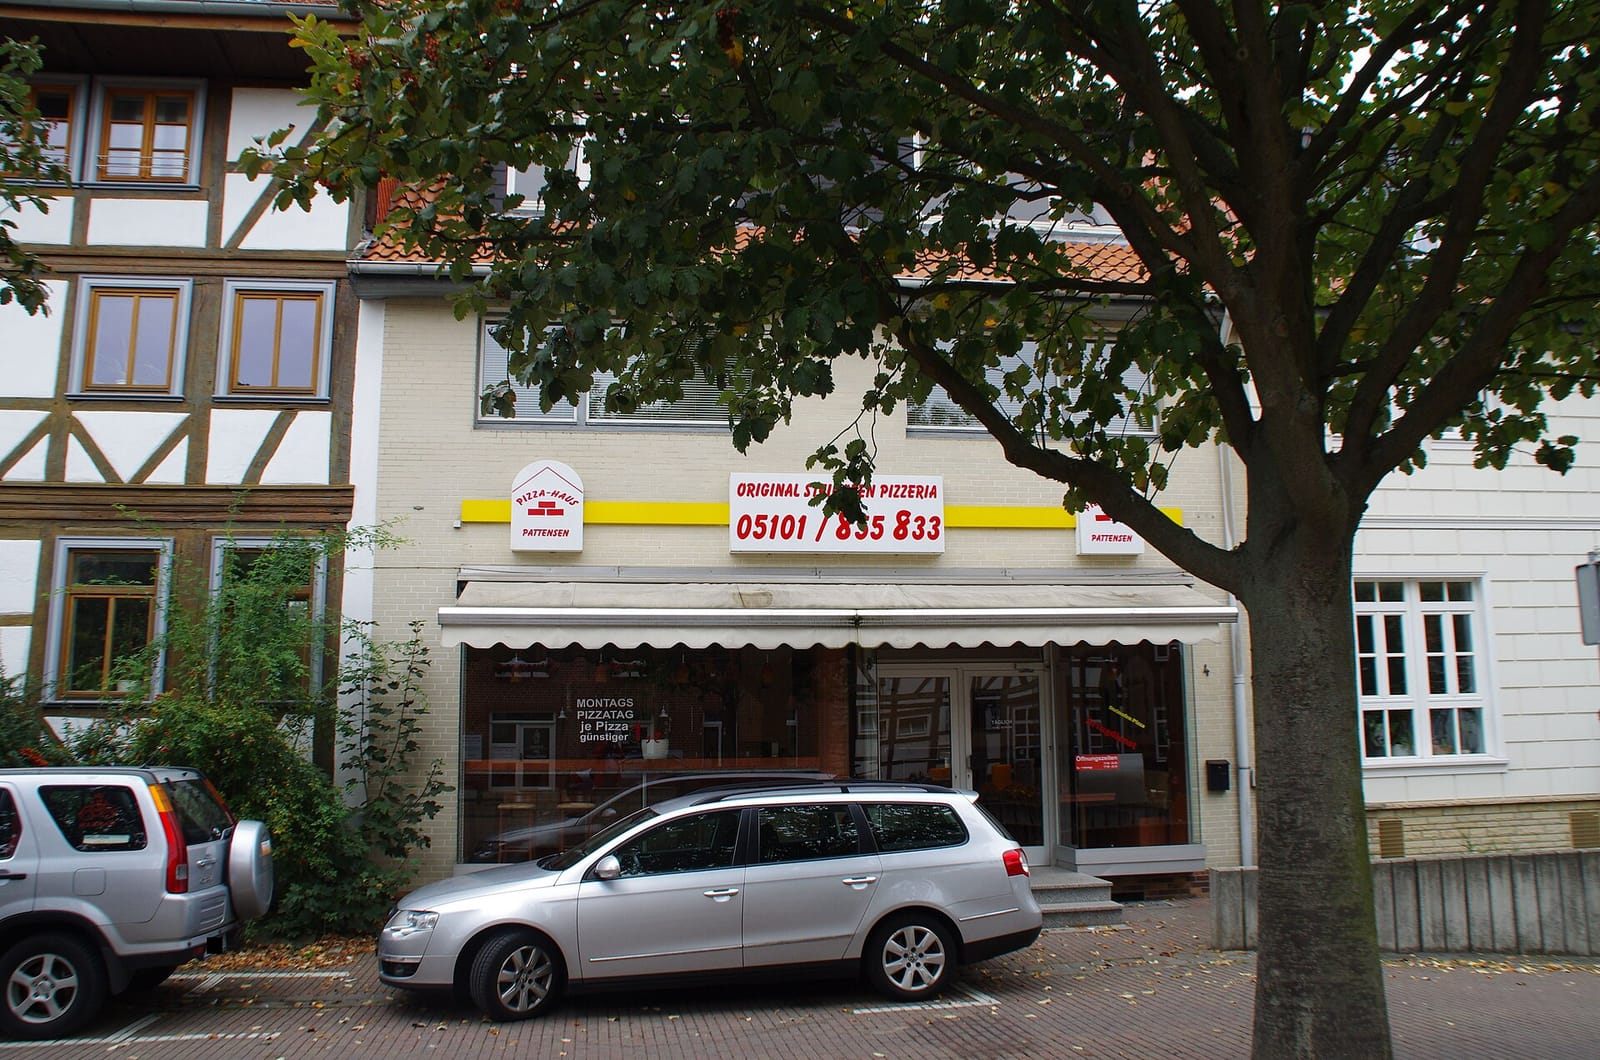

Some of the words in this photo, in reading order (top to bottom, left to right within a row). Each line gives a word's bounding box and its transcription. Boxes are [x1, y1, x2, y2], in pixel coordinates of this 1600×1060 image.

[736, 482, 800, 498] ORIGINAL
[879, 484, 938, 500] PIZZERIA
[516, 489, 579, 506] PIZZA-HAUS
[736, 513, 808, 540] 05101
[892, 509, 941, 541] 833
[522, 528, 570, 537] PATTENSEN
[1090, 534, 1133, 543] PATTENSEN
[576, 698, 634, 708] MONTAGS
[576, 710, 634, 720] PIZZATAG
[580, 721, 592, 734] je
[596, 721, 629, 731] Pizza
[579, 732, 629, 743] günstiger
